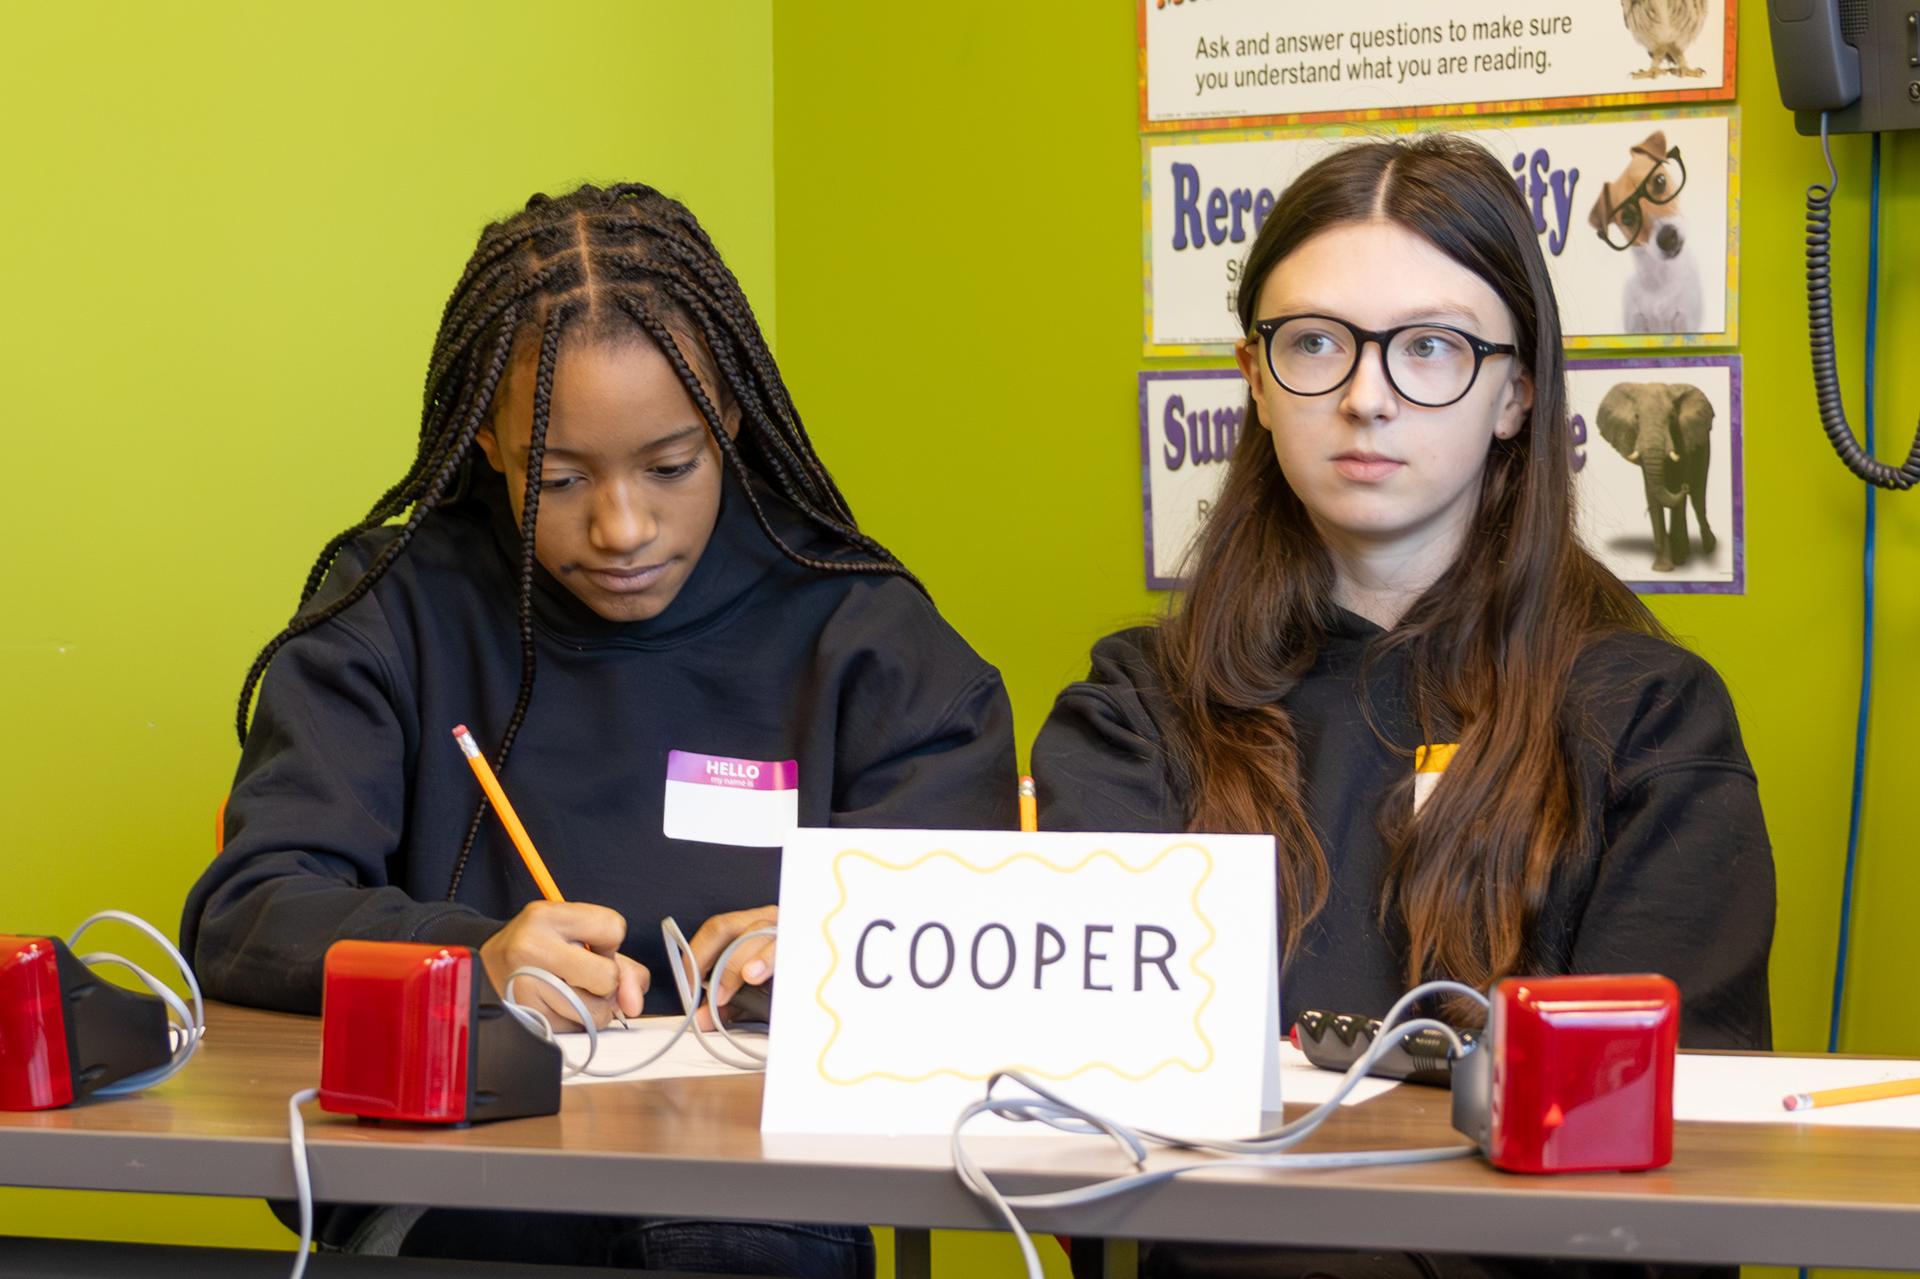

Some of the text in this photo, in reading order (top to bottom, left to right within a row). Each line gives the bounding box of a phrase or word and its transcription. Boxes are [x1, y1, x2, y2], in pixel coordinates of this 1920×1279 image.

[1195, 14, 1572, 59] Ask and answer questions to make sure
[1195, 46, 1552, 96] you understand what you are reading.
[706, 760, 760, 780] HELLO
[710, 776, 722, 786] my
[724, 777, 746, 787] name
[855, 919, 1181, 992] COOPER
